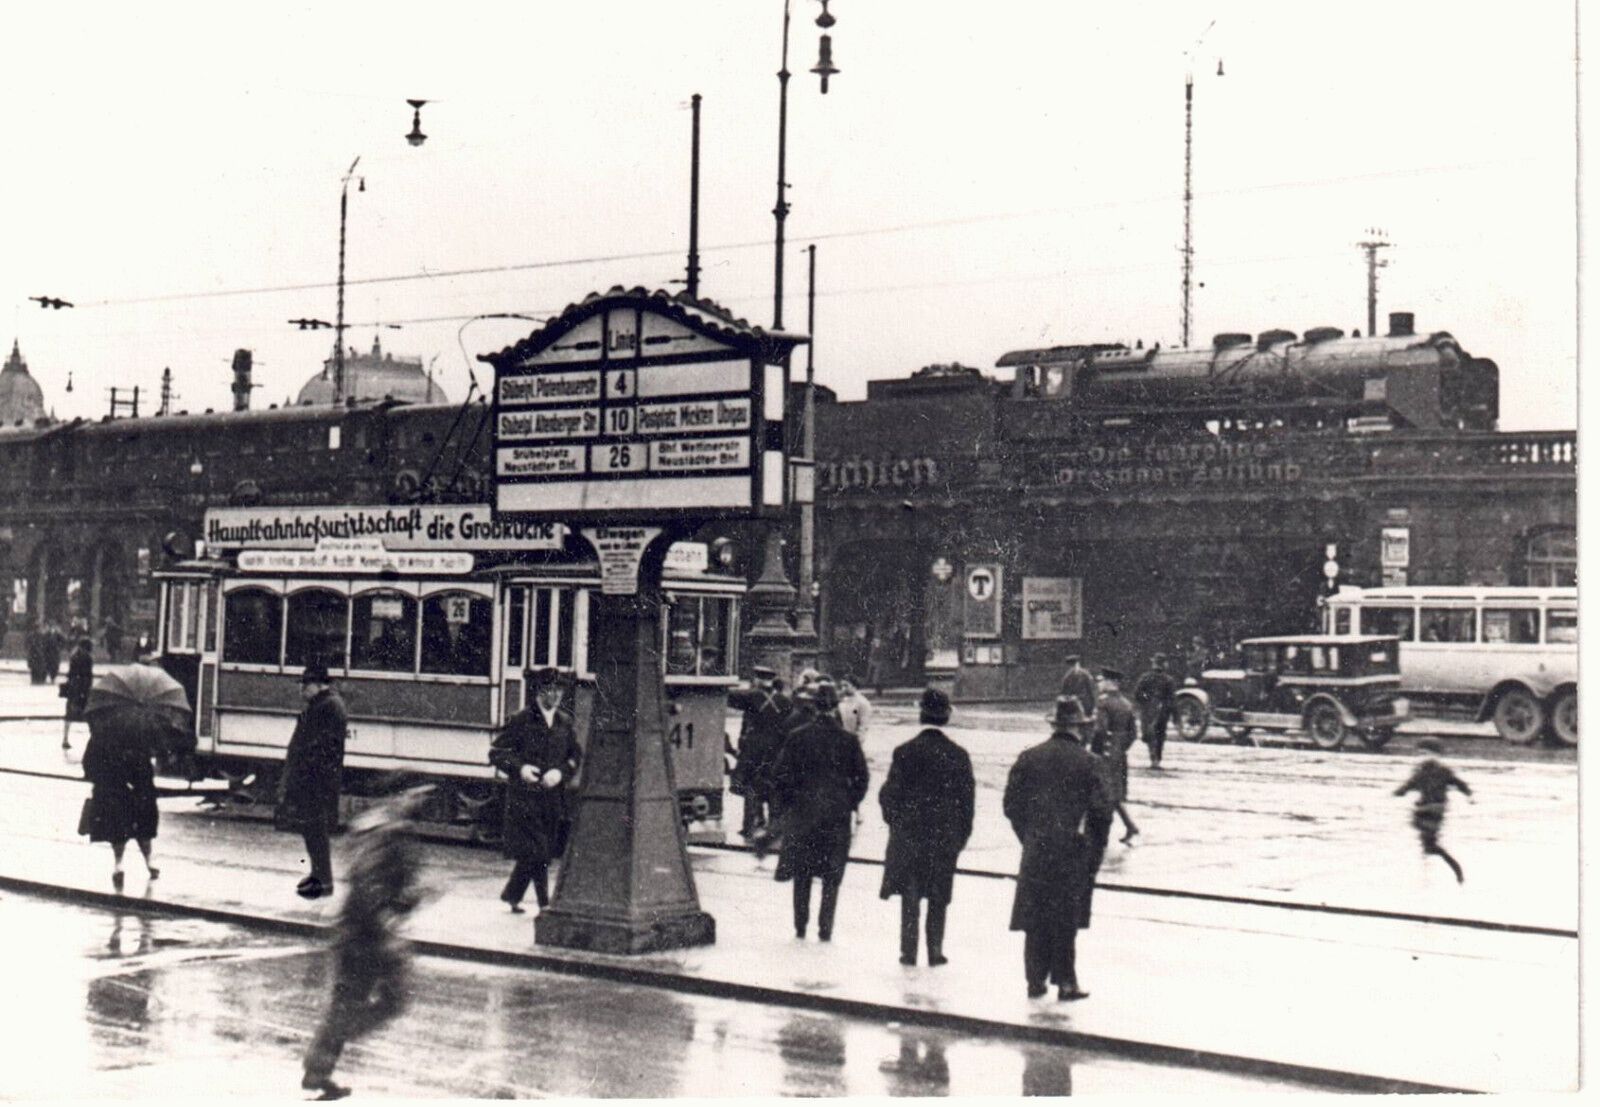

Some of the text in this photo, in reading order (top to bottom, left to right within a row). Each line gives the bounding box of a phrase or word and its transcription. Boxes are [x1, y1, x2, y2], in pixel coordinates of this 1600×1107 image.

[608, 327, 636, 352] Linie
[614, 371, 627, 395] 4
[610, 409, 629, 432] 10
[638, 406, 676, 431] Postplatz
[679, 404, 715, 427] Mickten
[513, 448, 569, 461] Stübelplatz
[609, 445, 631, 468] 26
[657, 453, 717, 467] Neustädter
[504, 461, 556, 473] Neustädter
[208, 508, 422, 546] Hauptbahnhofswirtschaft
[426, 513, 455, 540] die
[972, 574, 990, 596] T
[452, 600, 468, 619] 26
[669, 722, 694, 749] 41
